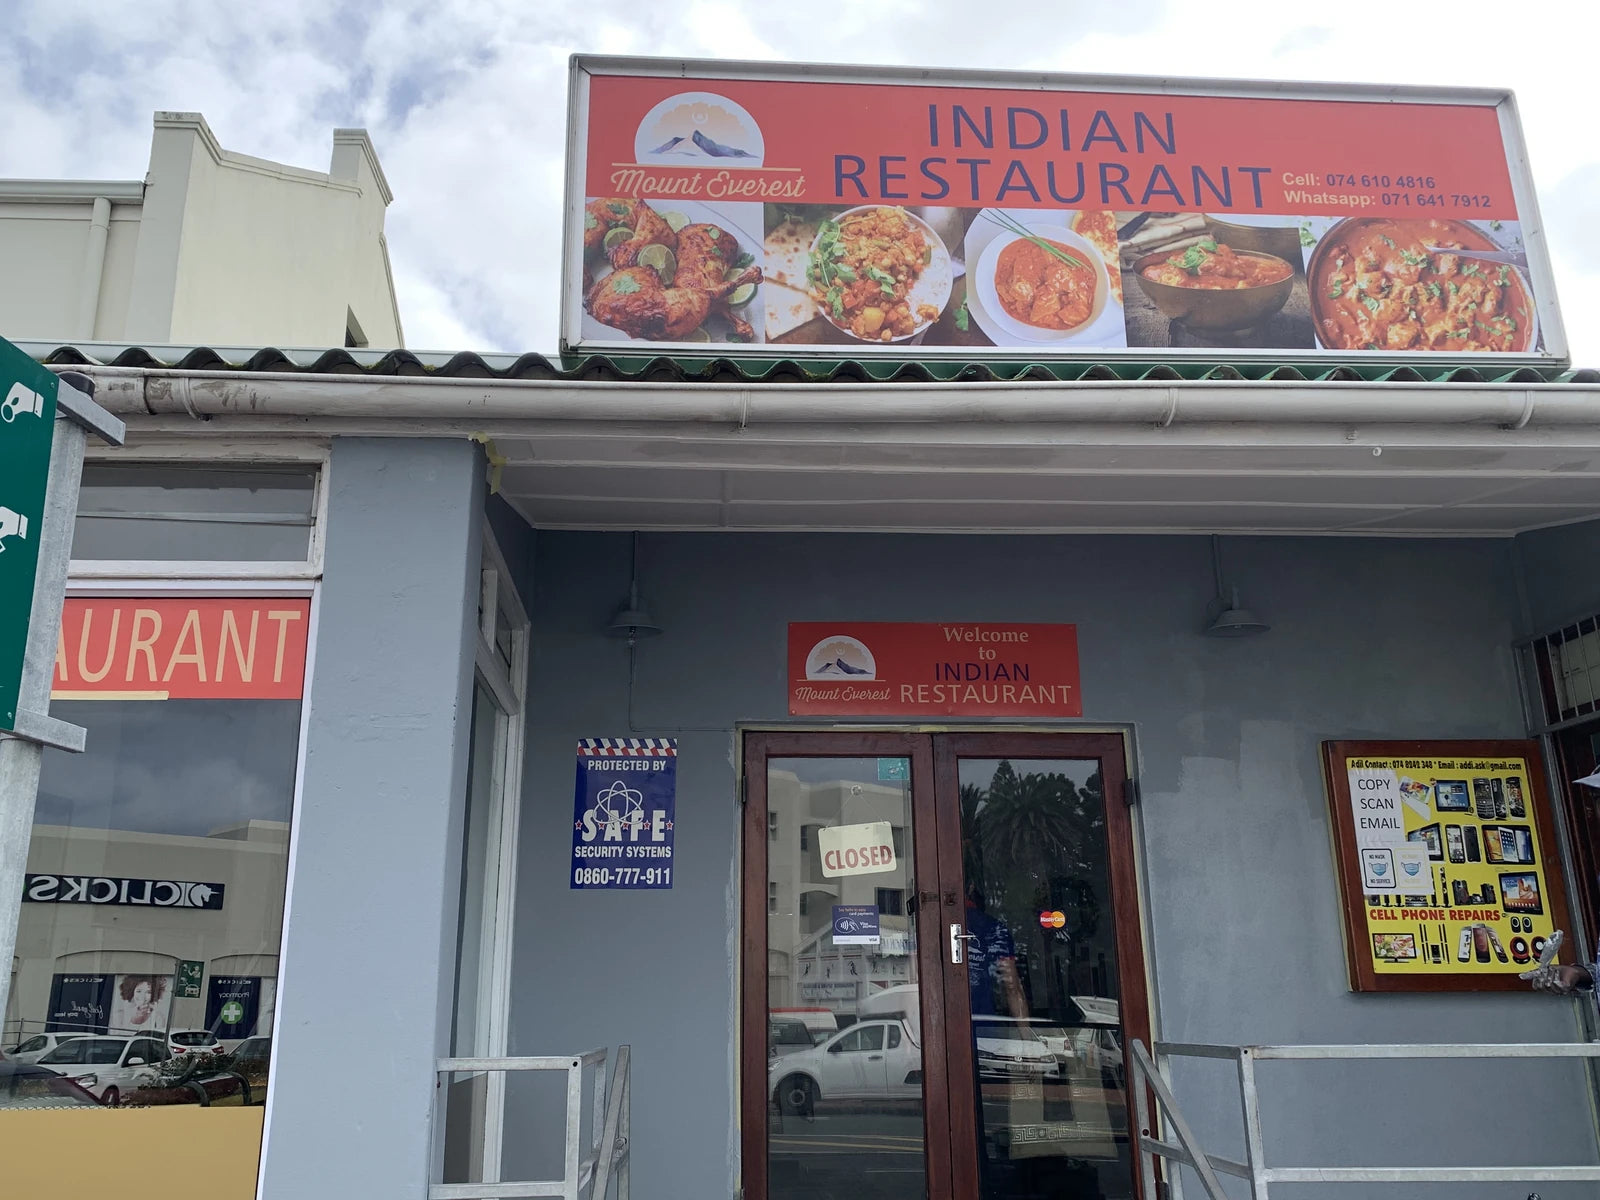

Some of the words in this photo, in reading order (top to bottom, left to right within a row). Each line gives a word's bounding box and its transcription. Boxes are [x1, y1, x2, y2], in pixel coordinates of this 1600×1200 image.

[929, 104, 1177, 155] INDIAN
[610, 168, 702, 197] Mount
[705, 171, 807, 199] Everest
[834, 154, 1272, 209] RESTAURANT
[1282, 172, 1321, 187] Cell:
[1326, 174, 1358, 187] 074
[1361, 174, 1391, 188] 610
[1395, 175, 1436, 189] 4816
[1284, 189, 1376, 208] Whatsapp:
[1381, 192, 1411, 206] 071
[1416, 193, 1446, 207] 641
[1451, 193, 1492, 208] 7912
[943, 626, 1029, 643] Welcome
[978, 645, 997, 661] to
[935, 662, 1029, 682] INDIAN
[795, 686, 841, 702] Mount
[842, 686, 892, 702] Everest
[901, 683, 1072, 705] RESTAURANT
[587, 759, 648, 771] PROTECTED
[652, 759, 667, 771] BY
[1365, 760, 1388, 769] Contact
[1438, 761, 1455, 769] Email
[1358, 779, 1391, 791] COPY
[1360, 798, 1394, 810] SCAN
[582, 808, 666, 842] SAFE
[1360, 817, 1401, 829] EMAIL
[574, 846, 626, 858] SECURITY
[626, 846, 672, 858] SYSTEMS
[824, 843, 893, 872] CLOSED
[574, 867, 671, 885] 0860-777-911
[1369, 909, 1398, 920] CELL
[1401, 909, 1446, 921] PHONE
[1449, 909, 1500, 921] REPAIRS
